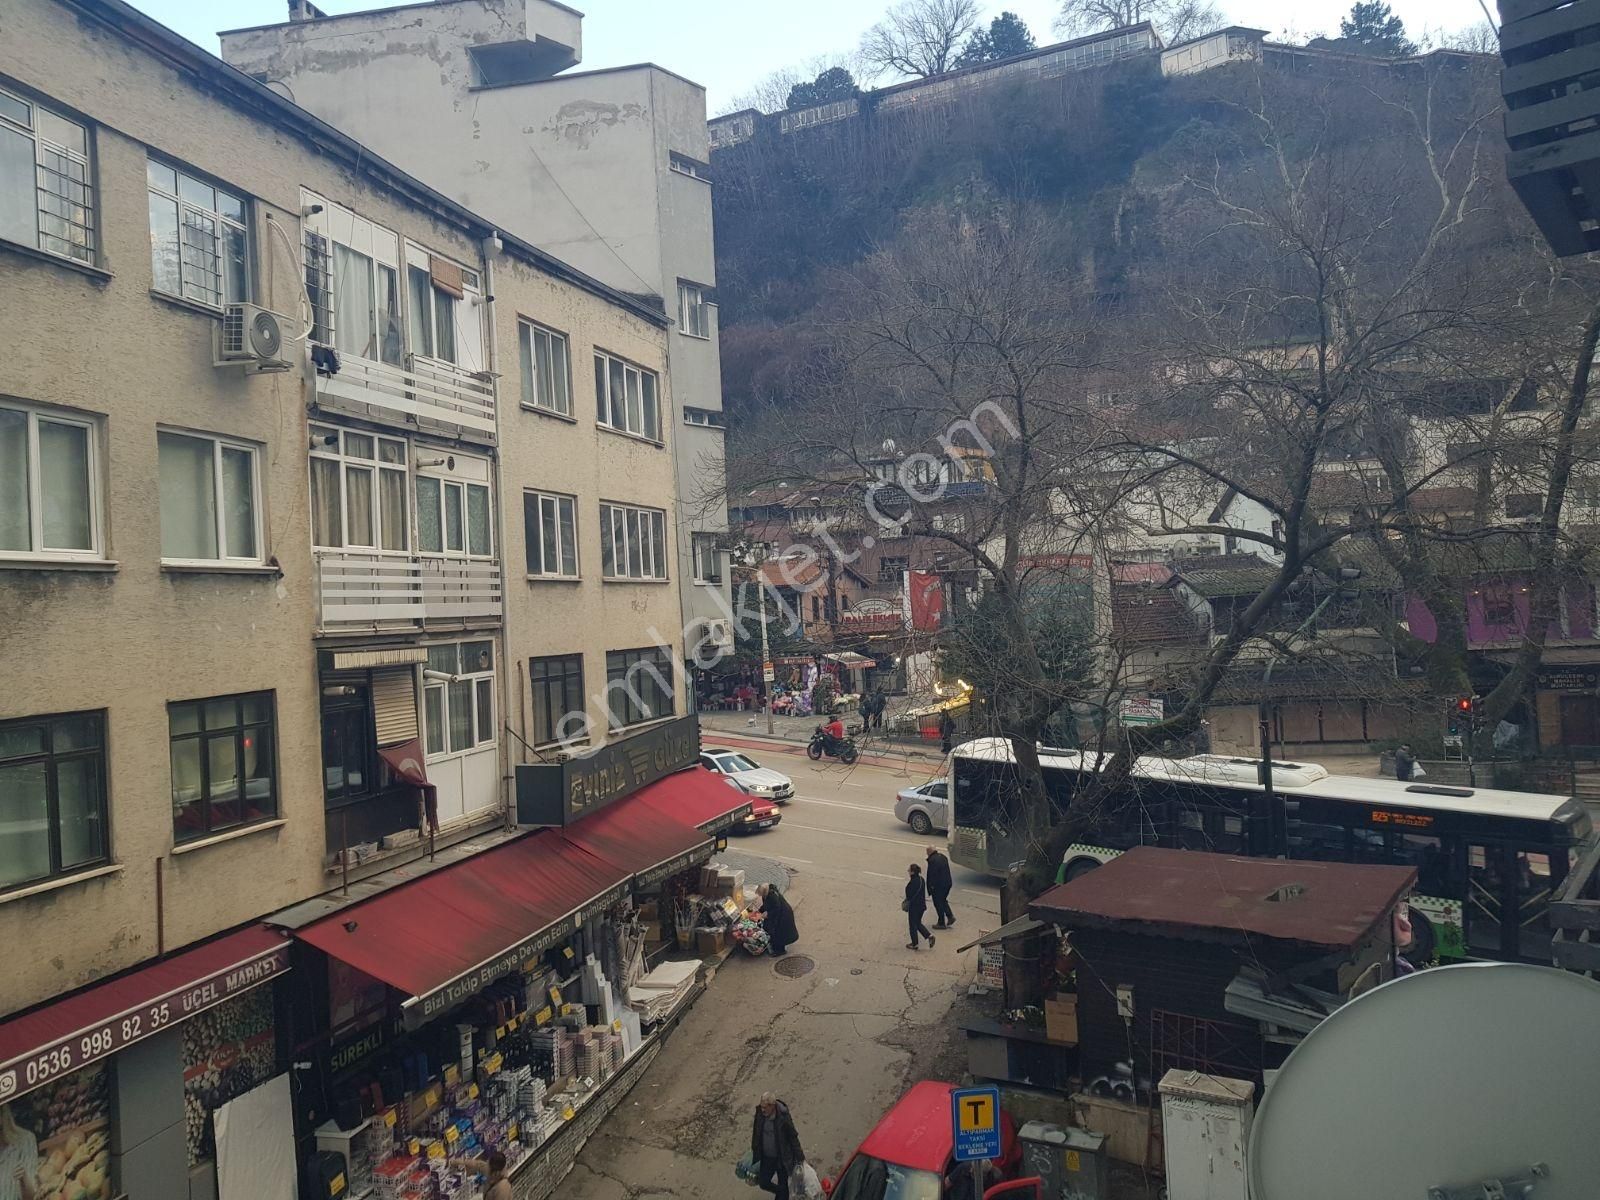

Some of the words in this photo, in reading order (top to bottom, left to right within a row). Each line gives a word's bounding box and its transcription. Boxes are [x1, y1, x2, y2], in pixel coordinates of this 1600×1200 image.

[424, 996, 446, 1015] Bizi
[448, 975, 478, 1000] Takip
[480, 953, 518, 982] Etmeye
[519, 934, 551, 960] Devam
[551, 922, 569, 938] Edin
[26, 1046, 71, 1085] 0536
[81, 1028, 112, 1059] 998
[122, 1015, 141, 1041] 82
[150, 1003, 169, 1028] 35
[182, 983, 219, 1012] ÜÇEL
[225, 954, 279, 992] MARKET
[967, 1100, 985, 1125] T
